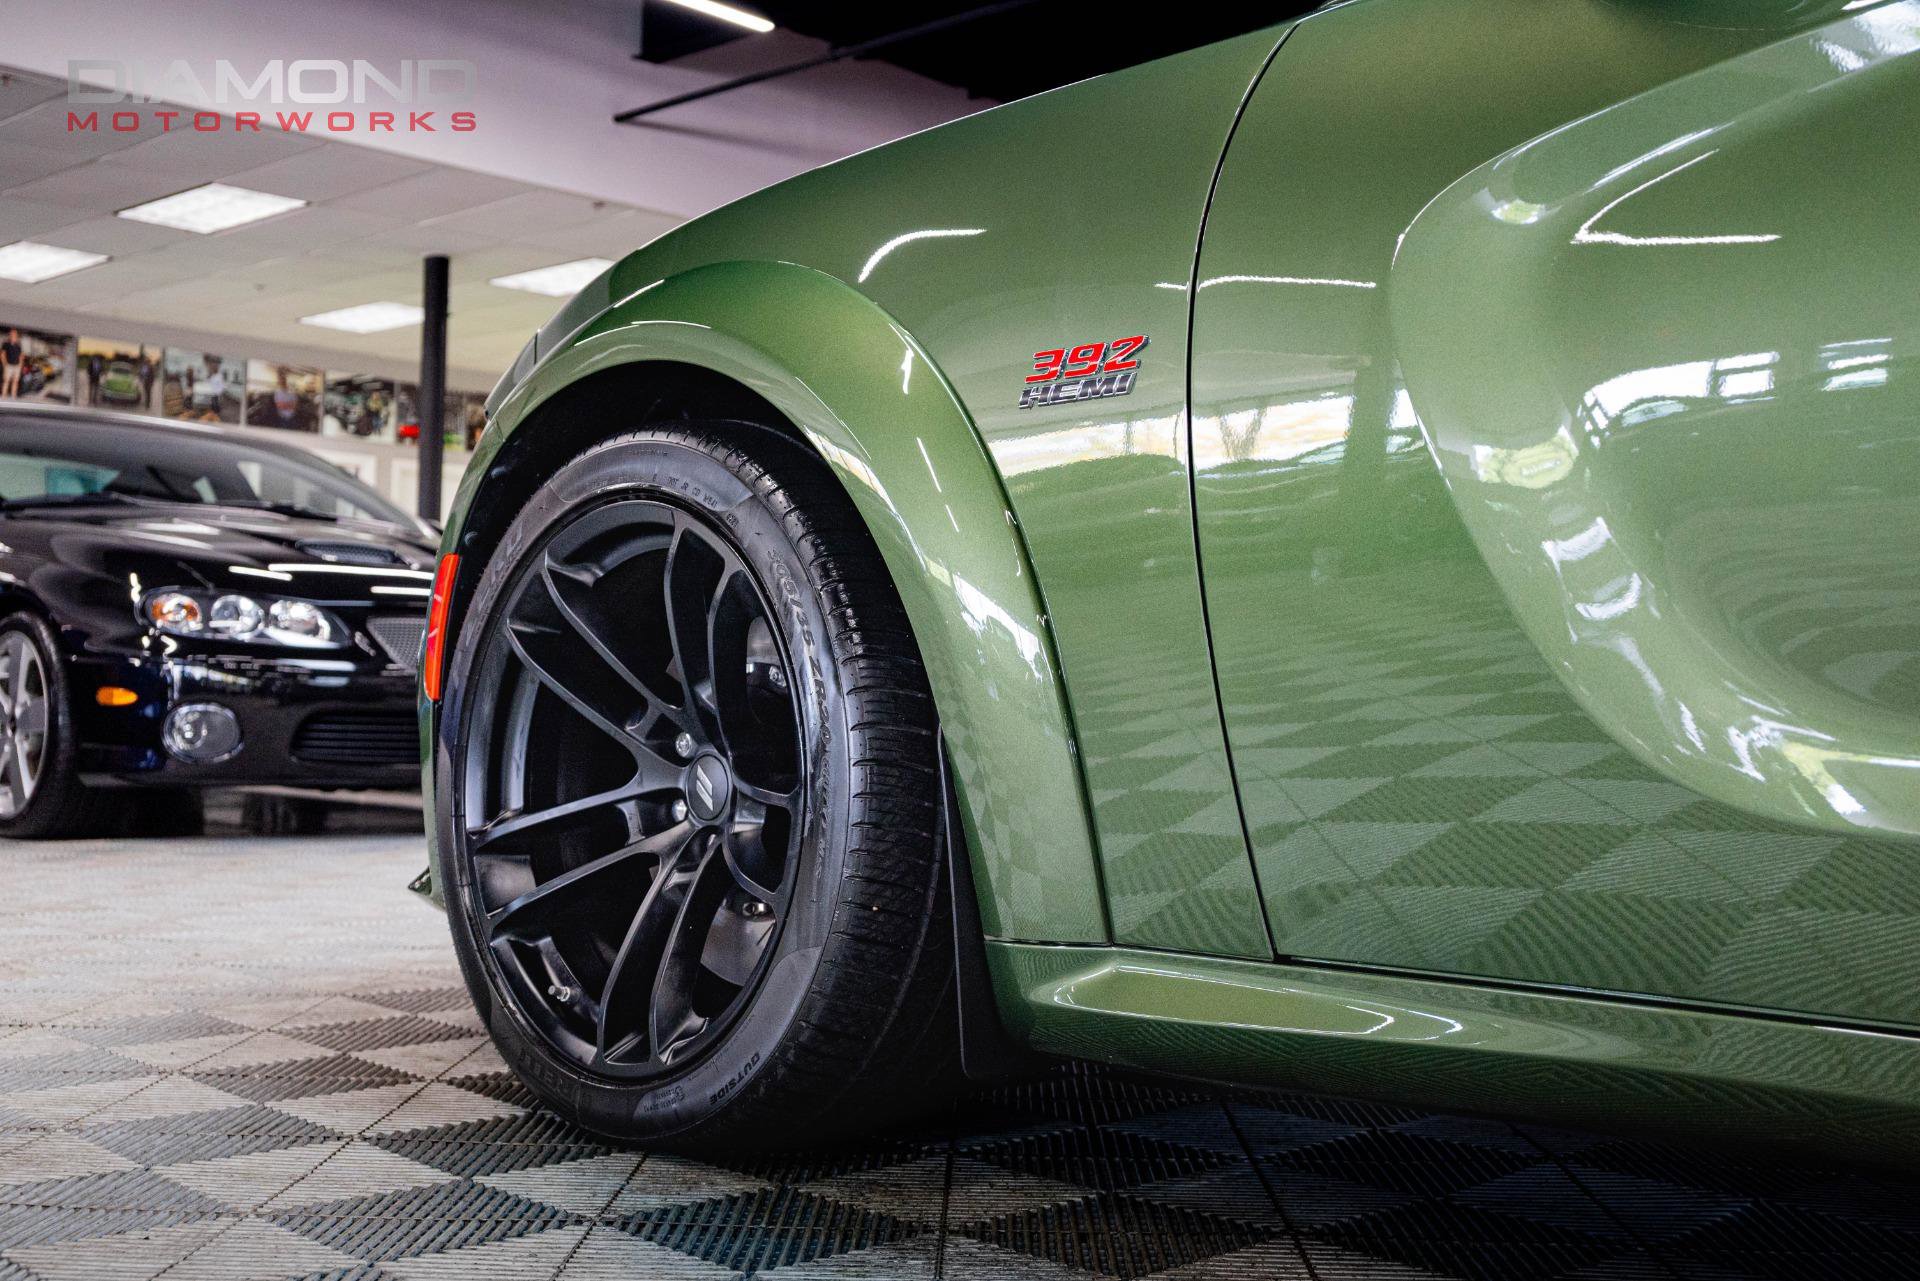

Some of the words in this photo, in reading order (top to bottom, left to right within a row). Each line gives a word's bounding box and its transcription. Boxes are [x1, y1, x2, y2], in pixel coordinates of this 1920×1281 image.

[1024, 334, 1150, 384] 392
[1018, 372, 1138, 410] HEMI
[766, 546, 815, 646] 305/35
[808, 653, 832, 745] ZR20
[709, 1051, 761, 1105] OUTSIDE
